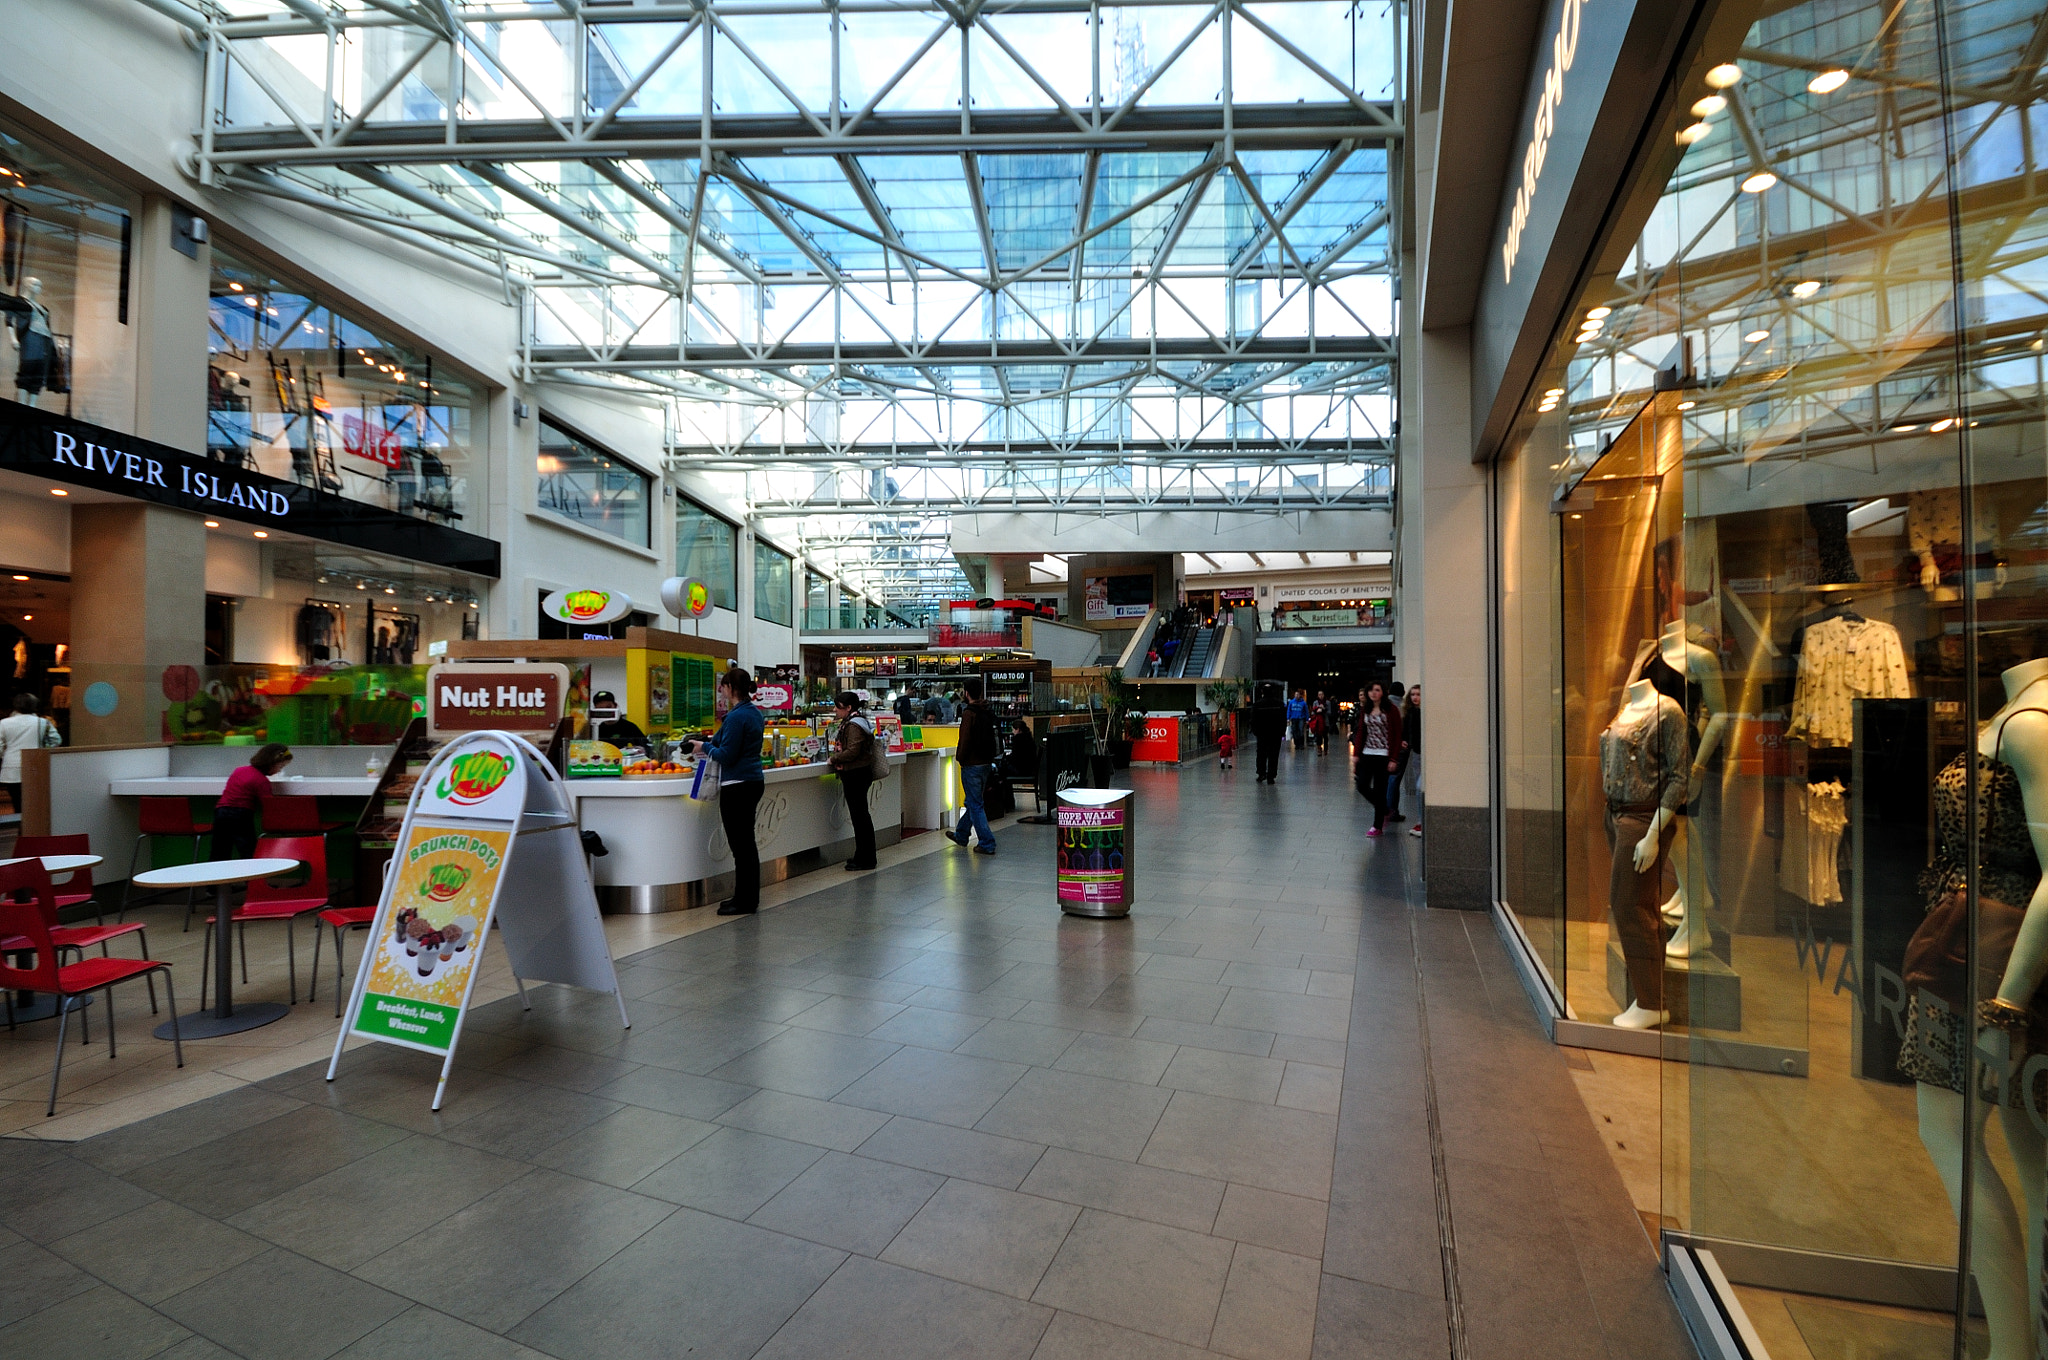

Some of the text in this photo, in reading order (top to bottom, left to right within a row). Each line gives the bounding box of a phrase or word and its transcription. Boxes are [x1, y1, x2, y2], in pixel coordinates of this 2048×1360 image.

[1503, 0, 1590, 285] WAREHO
[347, 427, 396, 465] SALE
[53, 431, 290, 517] RIVER ISLAND
[1281, 589, 1306, 597] UNITED
[1353, 586, 1391, 594] BENETTON
[1087, 600, 1104, 610] Gift
[992, 672, 1025, 680] GRAB TO GO
[441, 685, 546, 708] Nut Hut
[1058, 810, 1116, 820] HOPE WALK
[409, 834, 500, 869] BRUNCH POTS
[376, 1000, 446, 1024] Breakfast, Lunch,
[388, 1017, 428, 1035] Whenever
